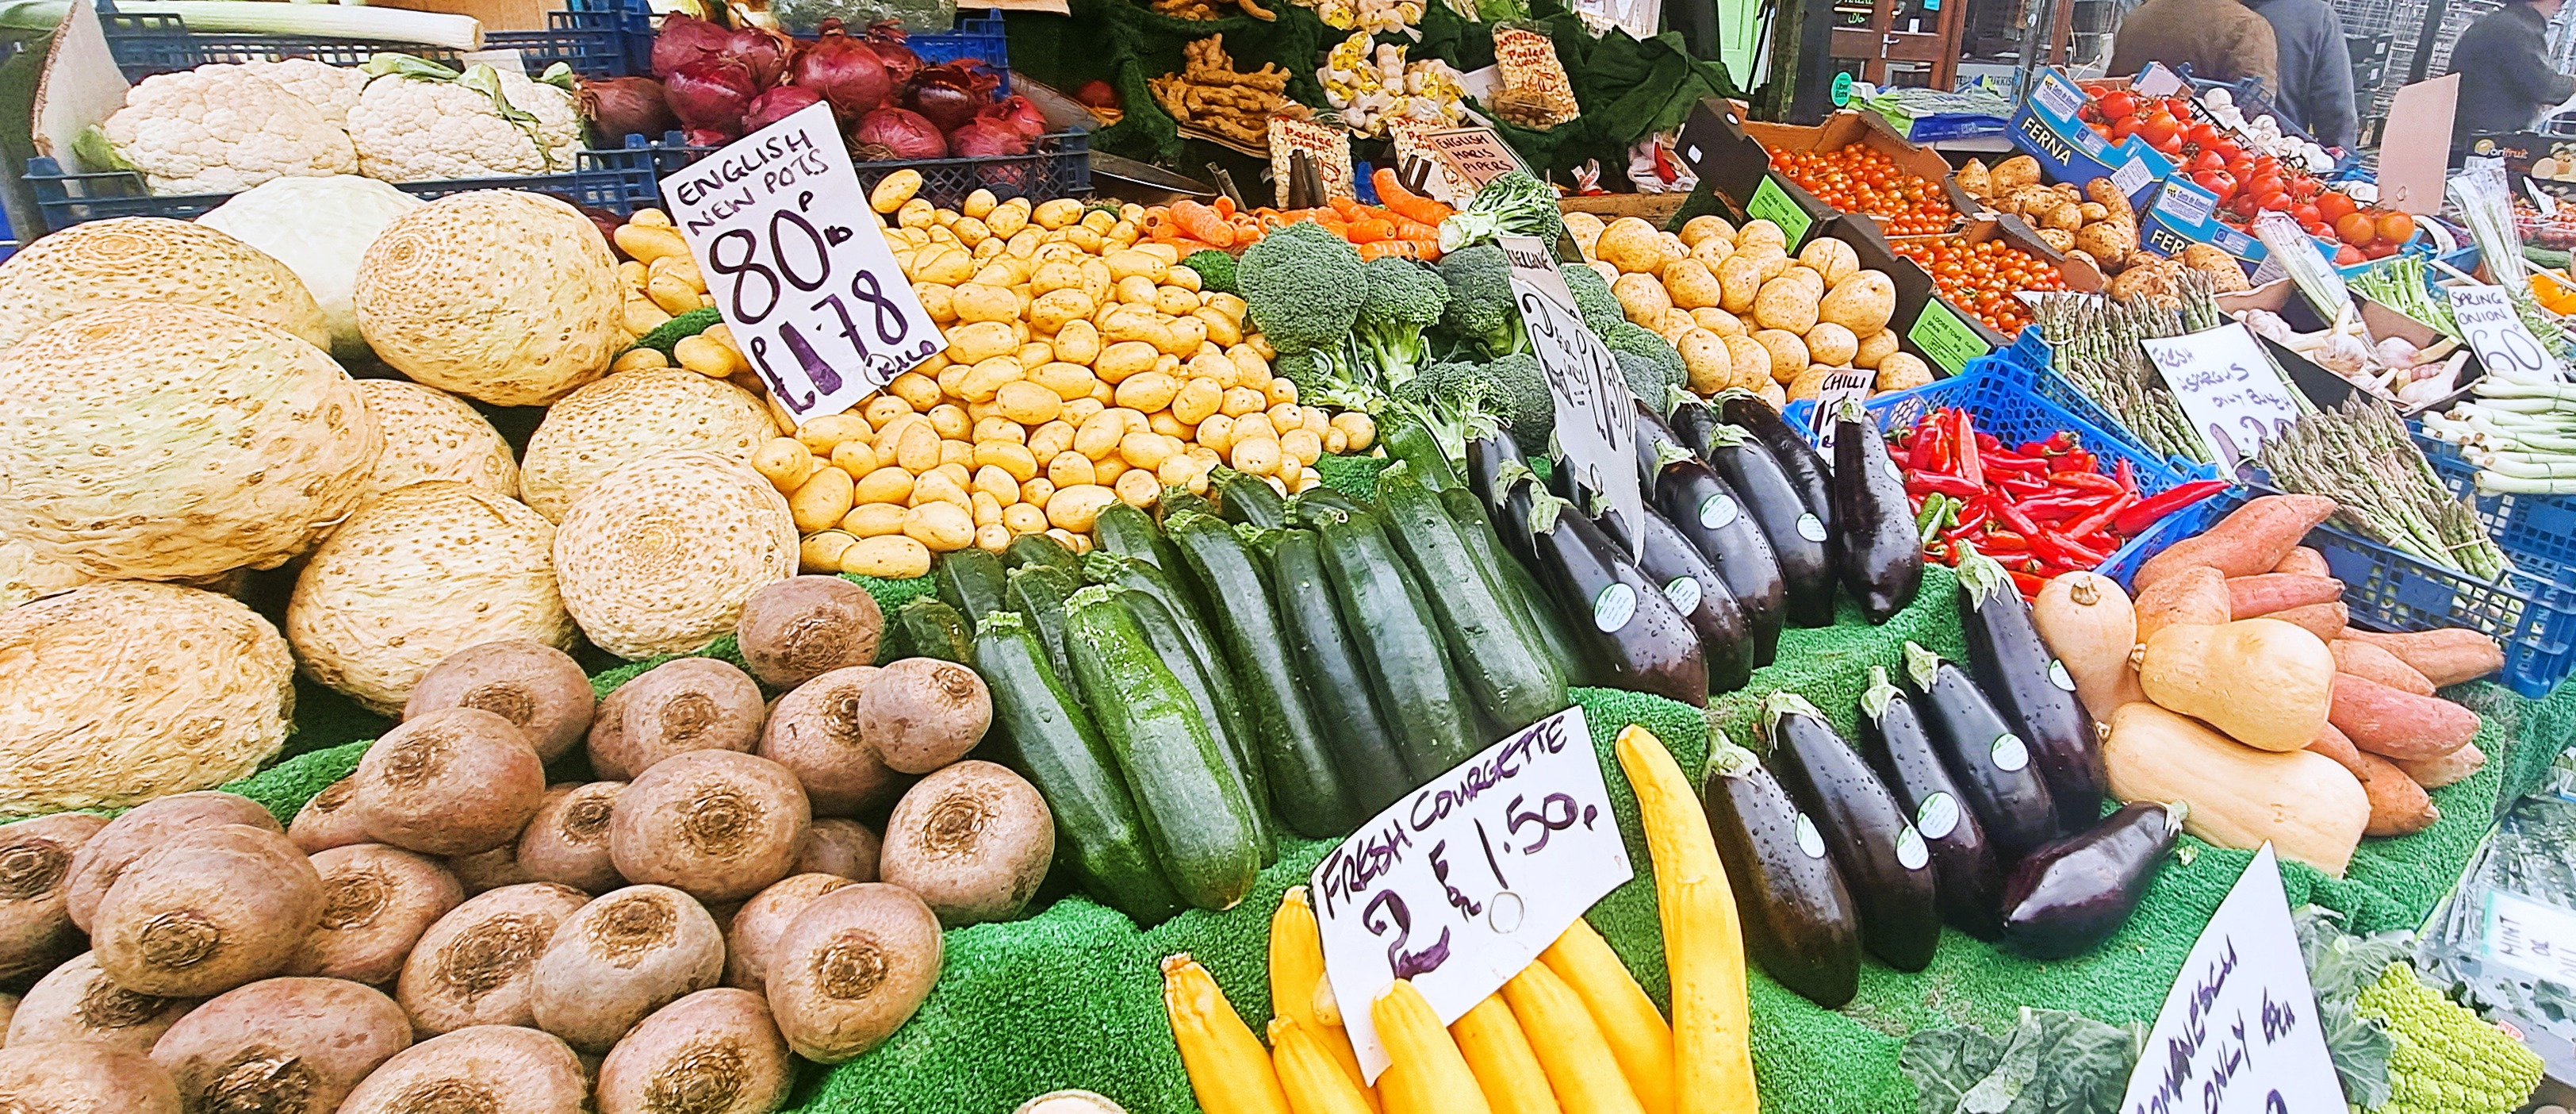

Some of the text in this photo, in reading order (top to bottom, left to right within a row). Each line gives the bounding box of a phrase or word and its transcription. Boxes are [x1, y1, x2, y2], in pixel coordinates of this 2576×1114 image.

[1285, 127, 1332, 148] Peeled
[1436, 134, 1489, 149] ENGLISH
[2022, 117, 2072, 167] FERNA
[1451, 148, 1496, 159] MARIS
[677, 128, 814, 206] ENGLISH
[1462, 160, 1514, 174] PIPERS
[687, 148, 830, 236] NEW POTS
[2150, 229, 2186, 254] FER
[2451, 292, 2504, 308] SPRING
[1932, 314, 1949, 330] LOOSE
[2458, 308, 2509, 325] ONION
[750, 269, 909, 416] £1.78
[1522, 293, 1574, 408] 2
[2152, 347, 2196, 372] FRESH
[1822, 373, 1866, 391] CHILLI
[2246, 388, 2293, 412] BUNCH
[1321, 715, 1568, 920] FRESH COURGETTE
[1363, 889, 1451, 982] 2
[2499, 914, 2523, 958] MINT
[2203, 1007, 2252, 1114] ONLY
